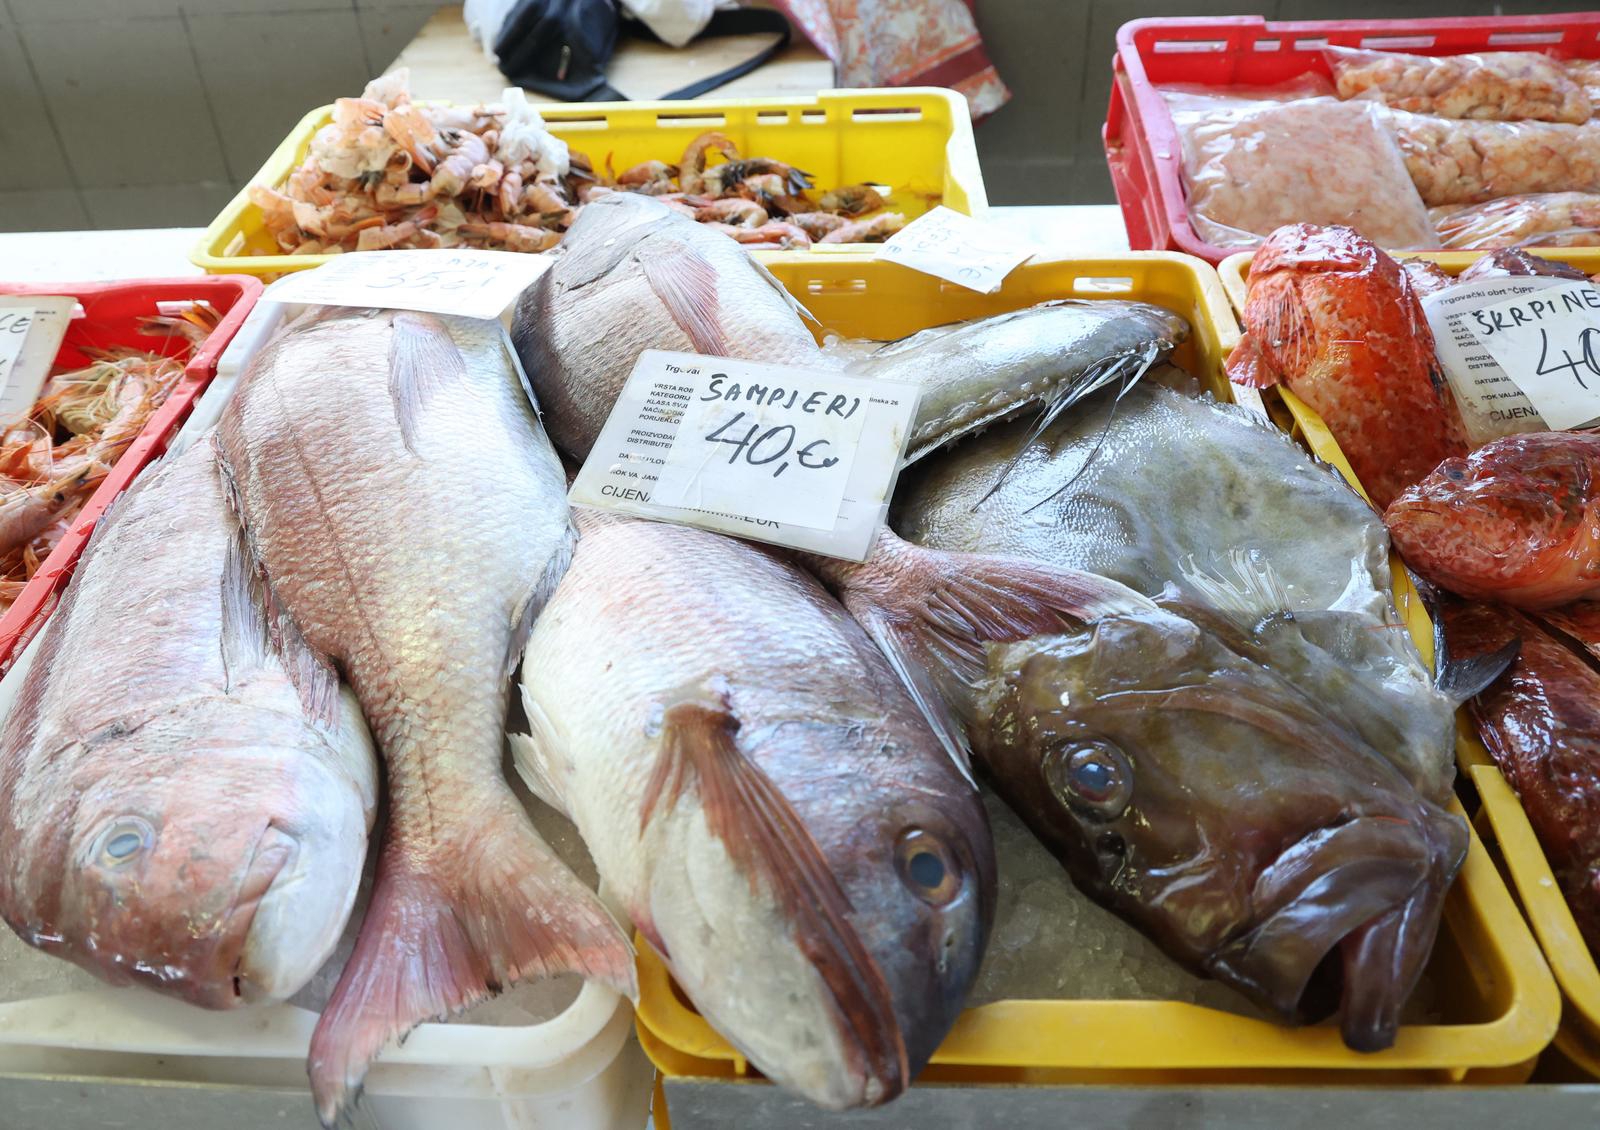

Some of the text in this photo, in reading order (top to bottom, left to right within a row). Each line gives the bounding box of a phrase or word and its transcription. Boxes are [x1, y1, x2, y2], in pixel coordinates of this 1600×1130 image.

[1487, 288, 1507, 297] obrt
[1474, 377, 1500, 385] DATUM
[654, 383, 677, 391] VRSTA
[700, 373, 861, 420] ŠAMPJERI
[646, 398, 670, 407] KLASA
[601, 484, 651, 503] CIJEN
